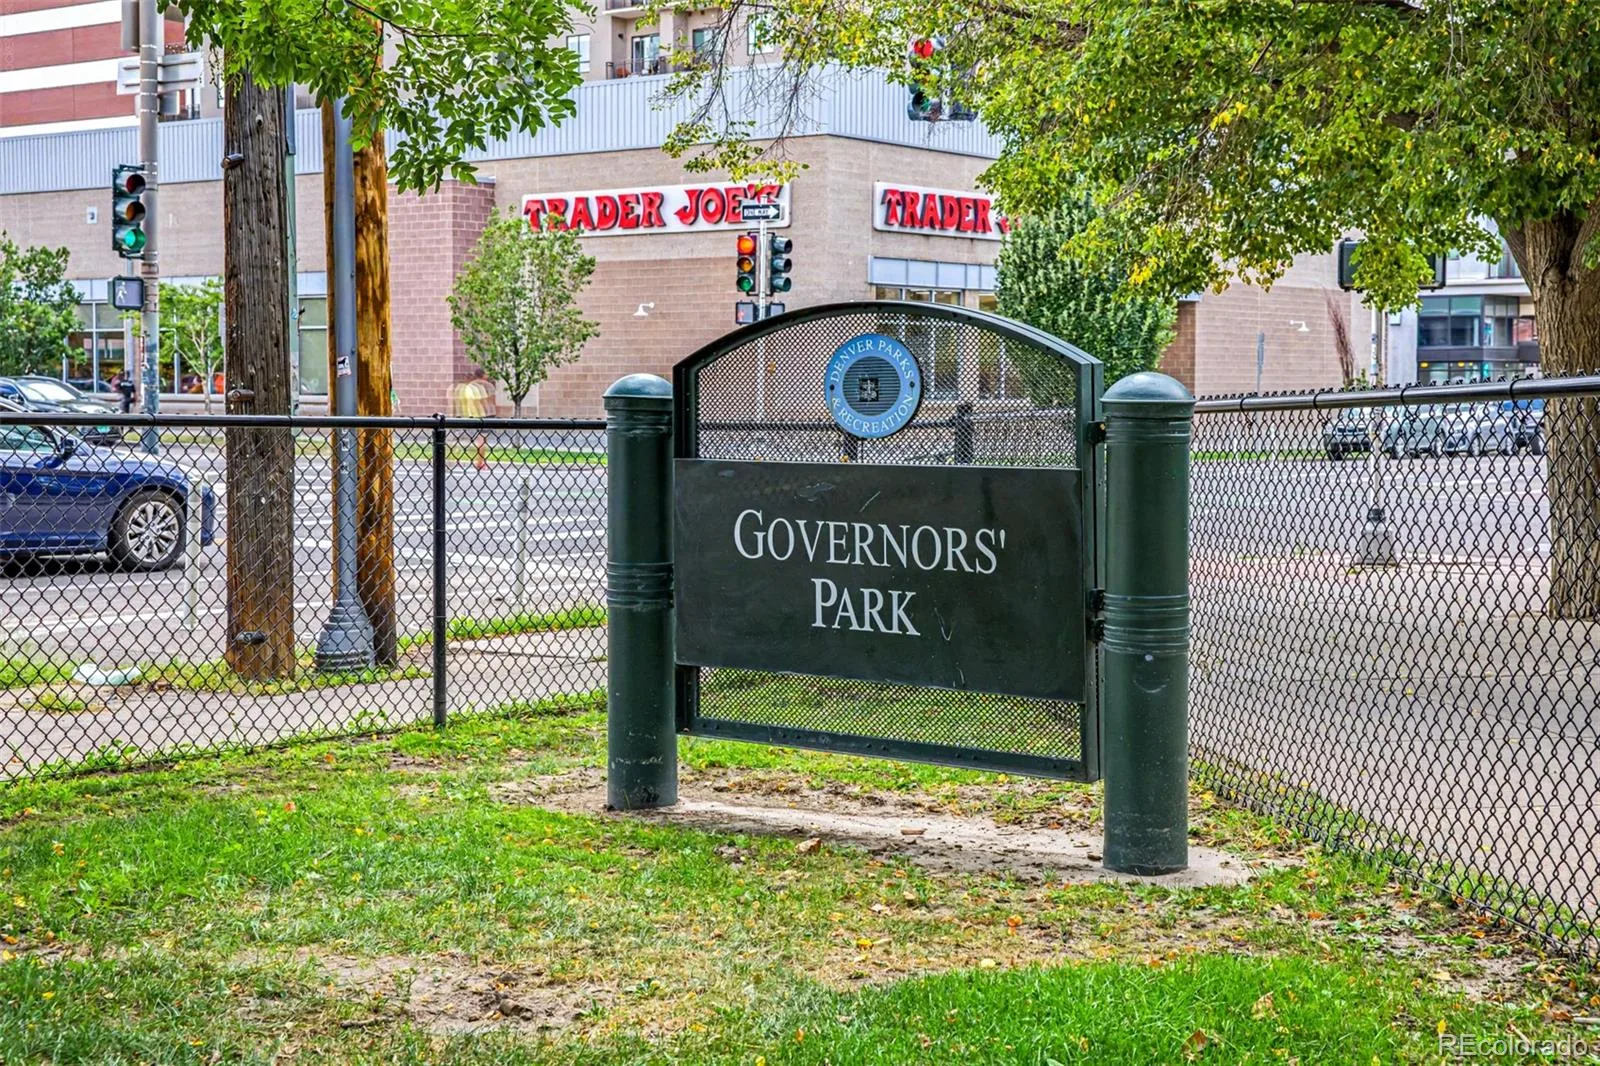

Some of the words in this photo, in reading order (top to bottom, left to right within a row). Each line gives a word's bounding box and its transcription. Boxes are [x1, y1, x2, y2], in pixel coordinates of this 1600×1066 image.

[523, 192, 665, 233] TRADER
[881, 188, 993, 234] TRADER
[831, 339, 874, 382] DENVER
[878, 340, 914, 379] PARKS
[832, 397, 841, 408] &
[838, 394, 913, 434] RECREATION
[733, 509, 1006, 575] GOVERNORS'
[811, 578, 921, 636] PARK
